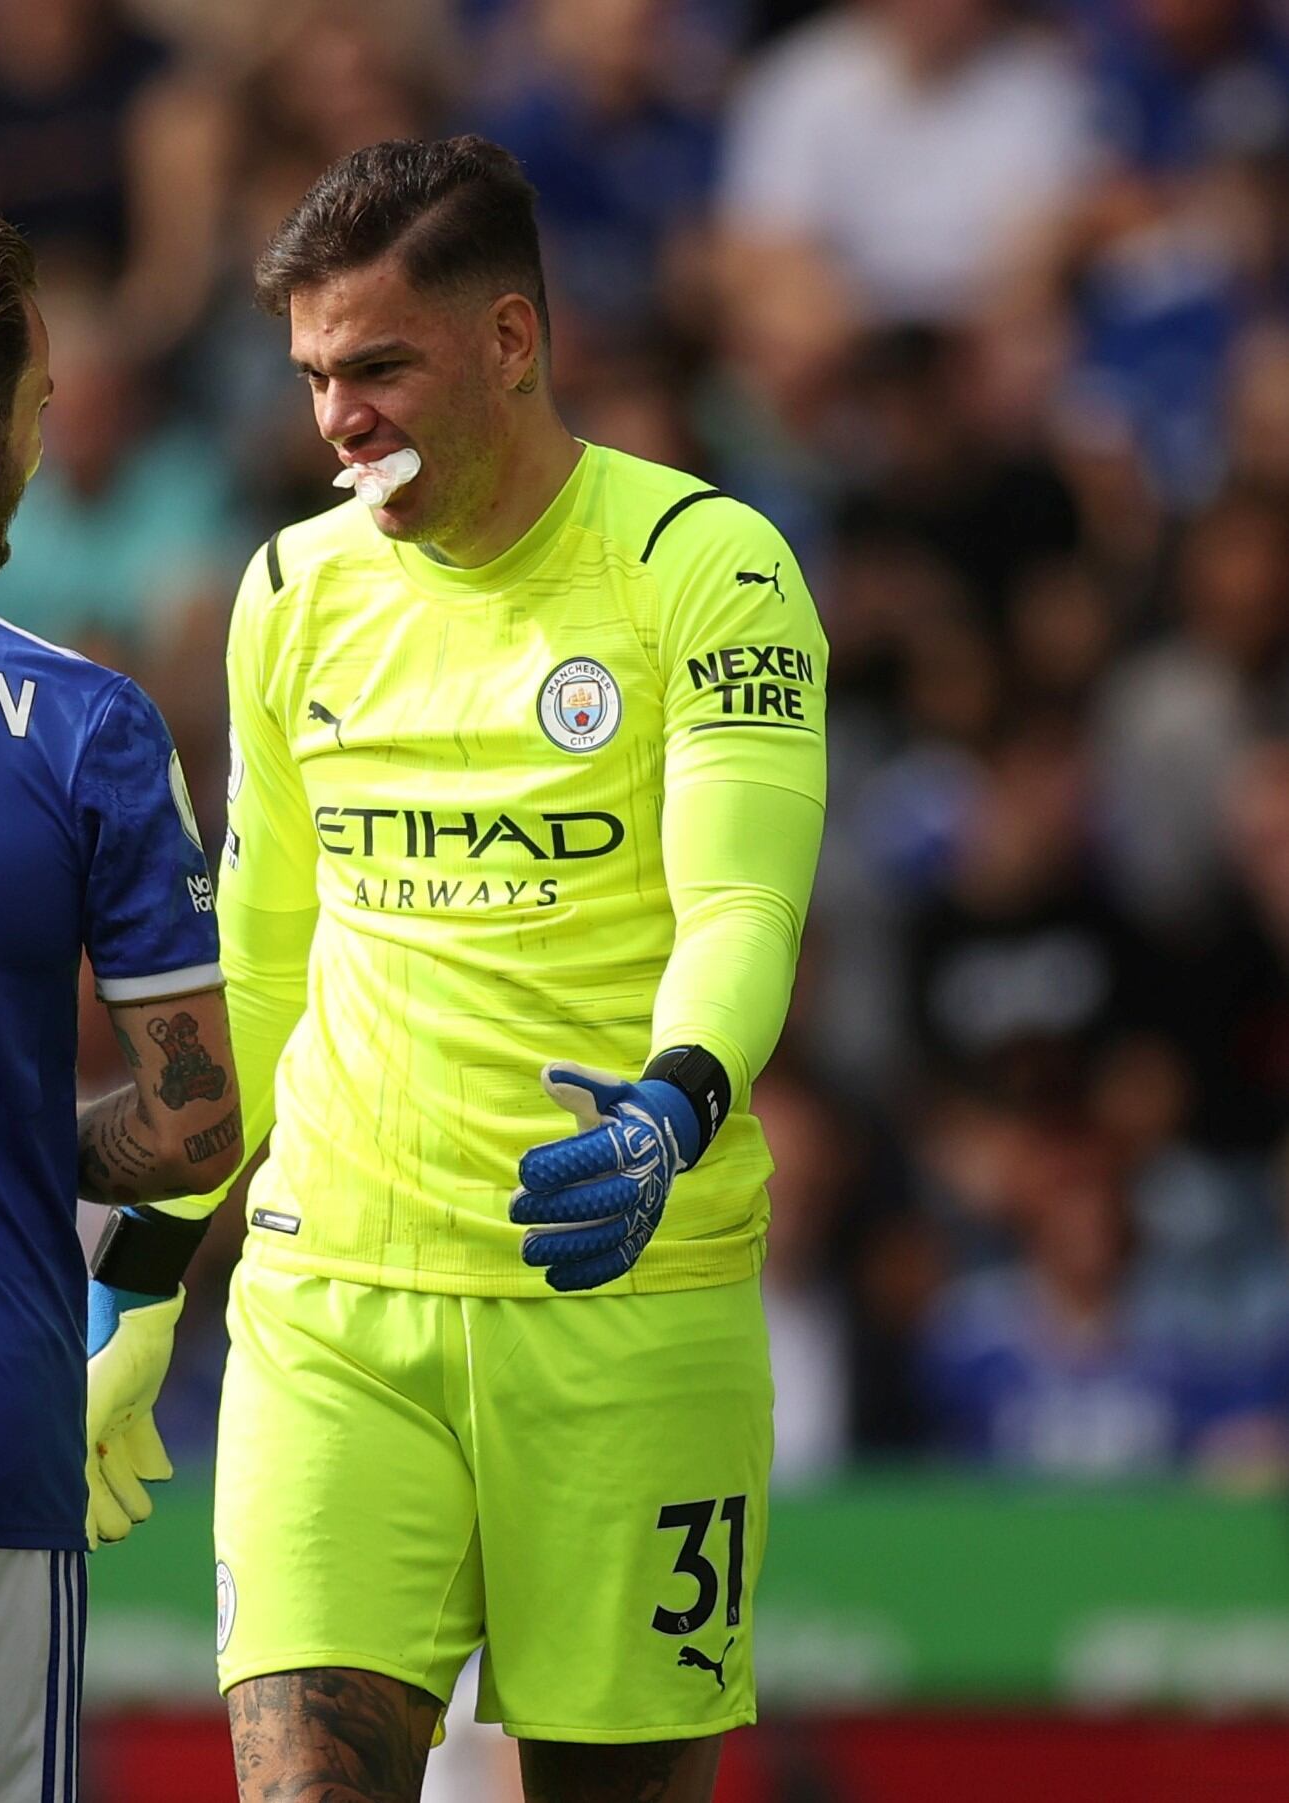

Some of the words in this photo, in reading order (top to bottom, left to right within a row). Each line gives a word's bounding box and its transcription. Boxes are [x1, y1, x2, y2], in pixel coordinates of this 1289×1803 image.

[547, 664, 611, 696] MANCHESTER
[687, 646, 814, 690] NEXEN
[714, 682, 804, 720] TIRE
[570, 736, 596, 746] CITY
[314, 805, 625, 861] ETIHAD
[186, 874, 210, 896] No
[353, 877, 559, 909] AIRWAYS
[652, 1495, 747, 1635] 31
